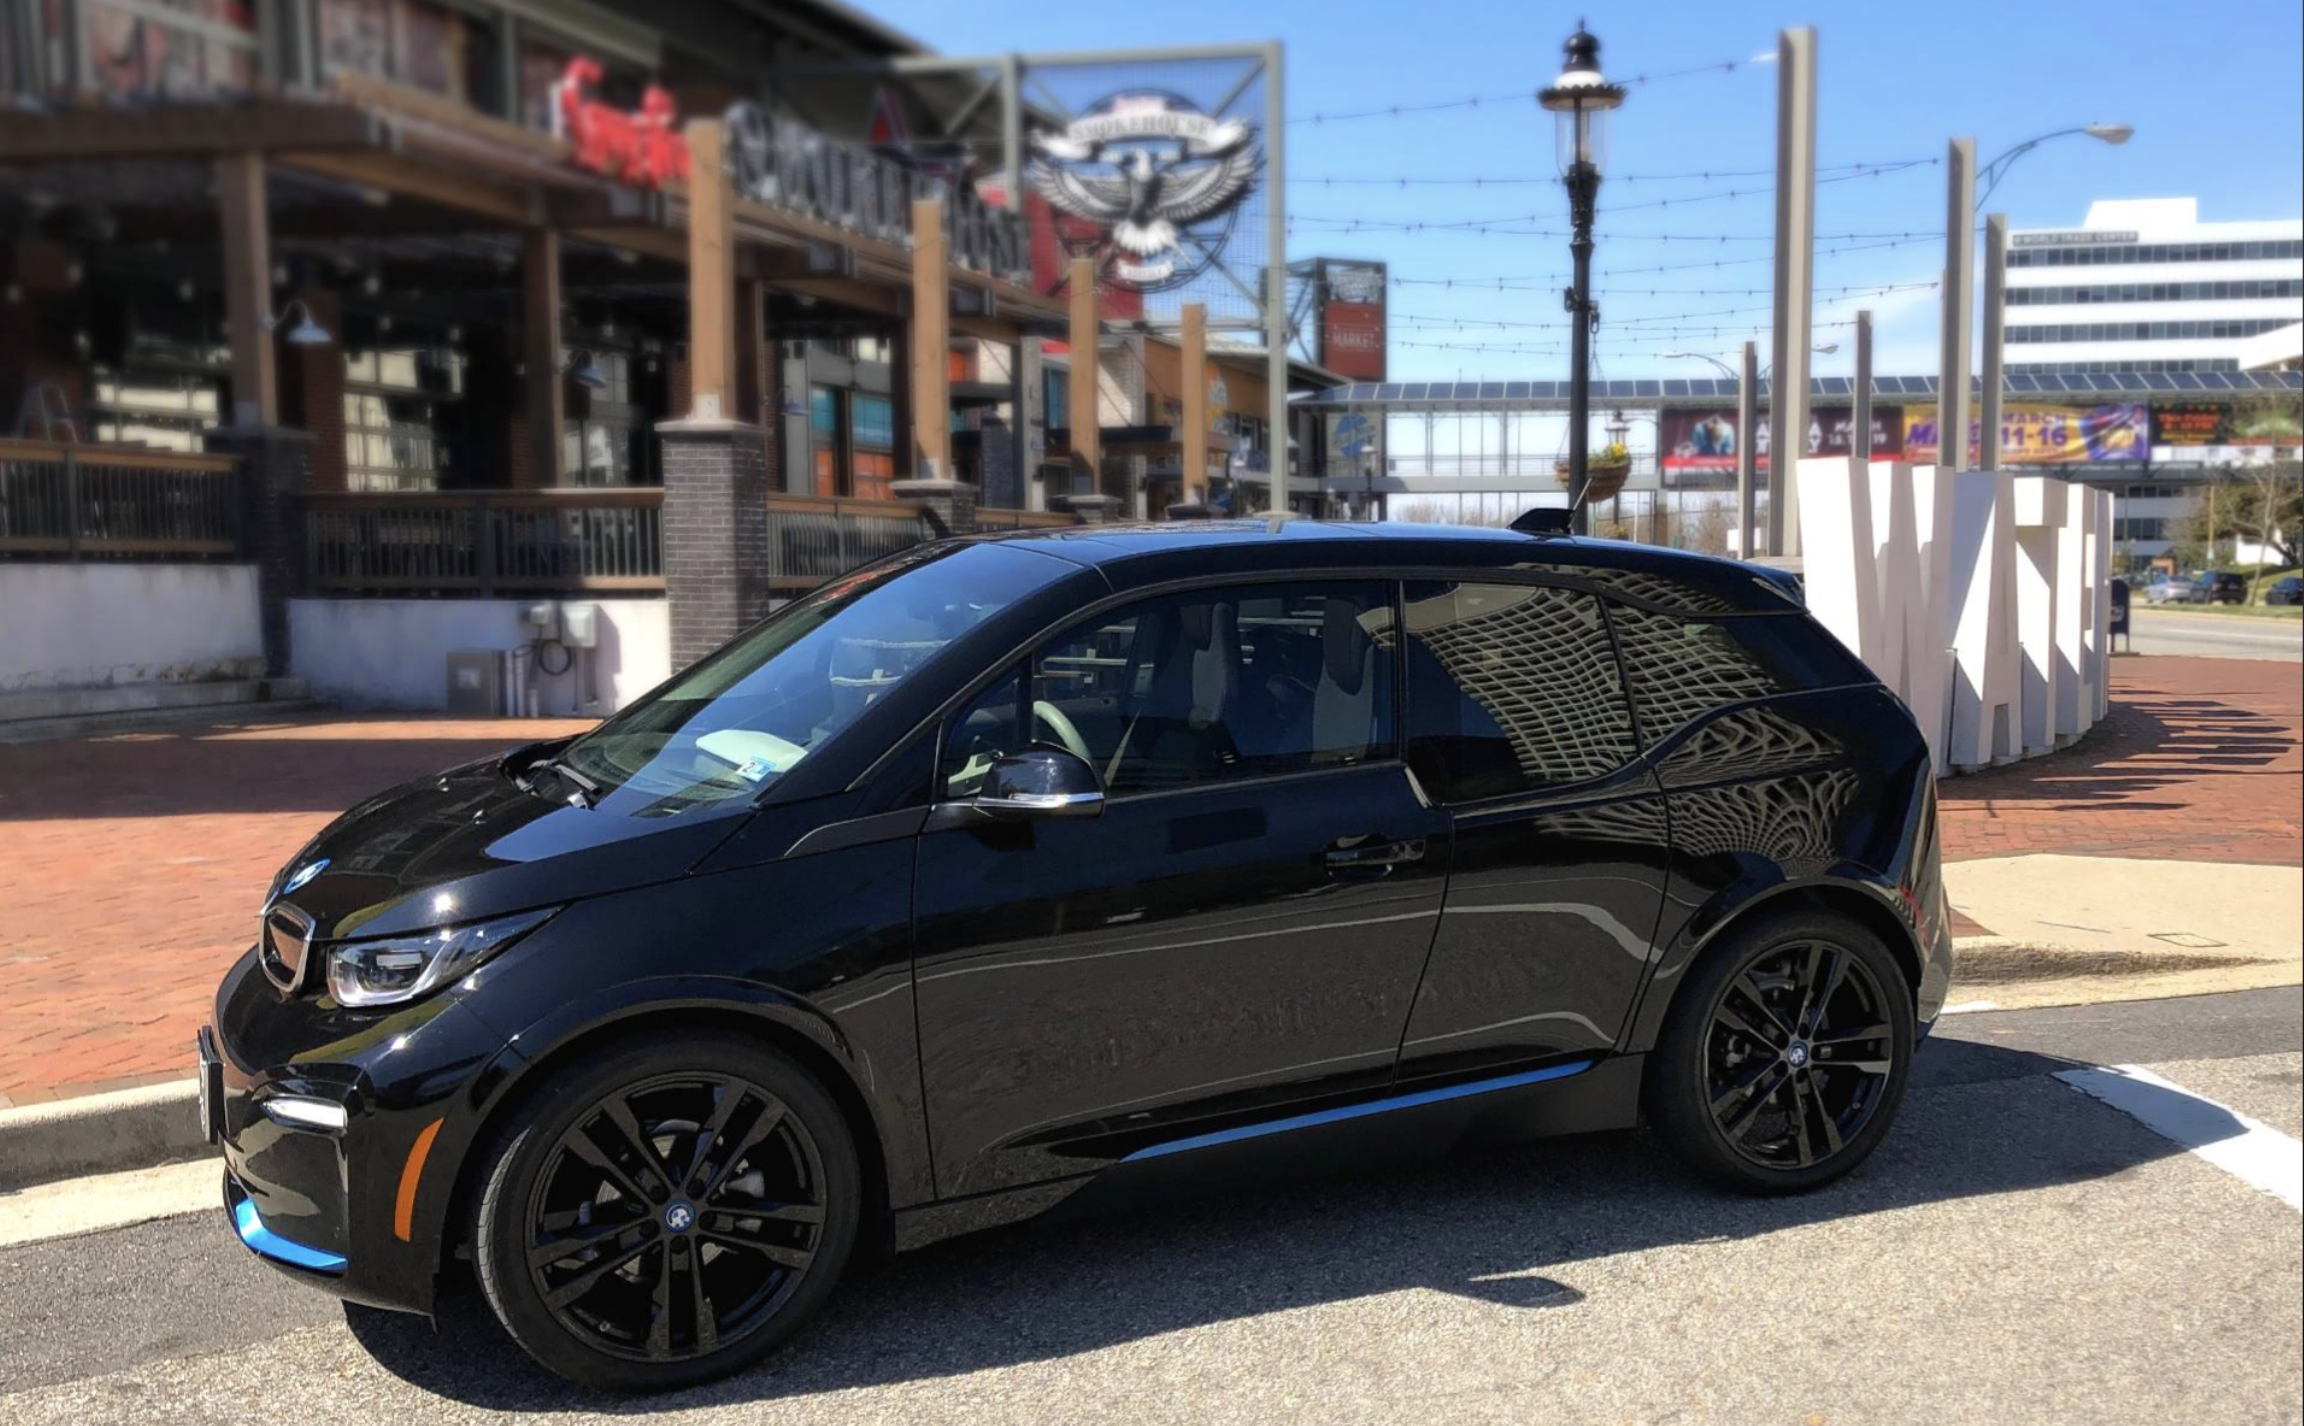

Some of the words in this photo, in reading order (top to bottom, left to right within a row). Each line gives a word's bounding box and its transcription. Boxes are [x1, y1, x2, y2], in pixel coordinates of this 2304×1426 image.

[1073, 115, 1209, 141] SMOKEHOUSE
[2095, 230, 2138, 244] CENTER
[1332, 331, 1375, 349] MARKET
[2001, 411, 2067, 425] MARCH
[2001, 425, 2069, 447] 11-16
